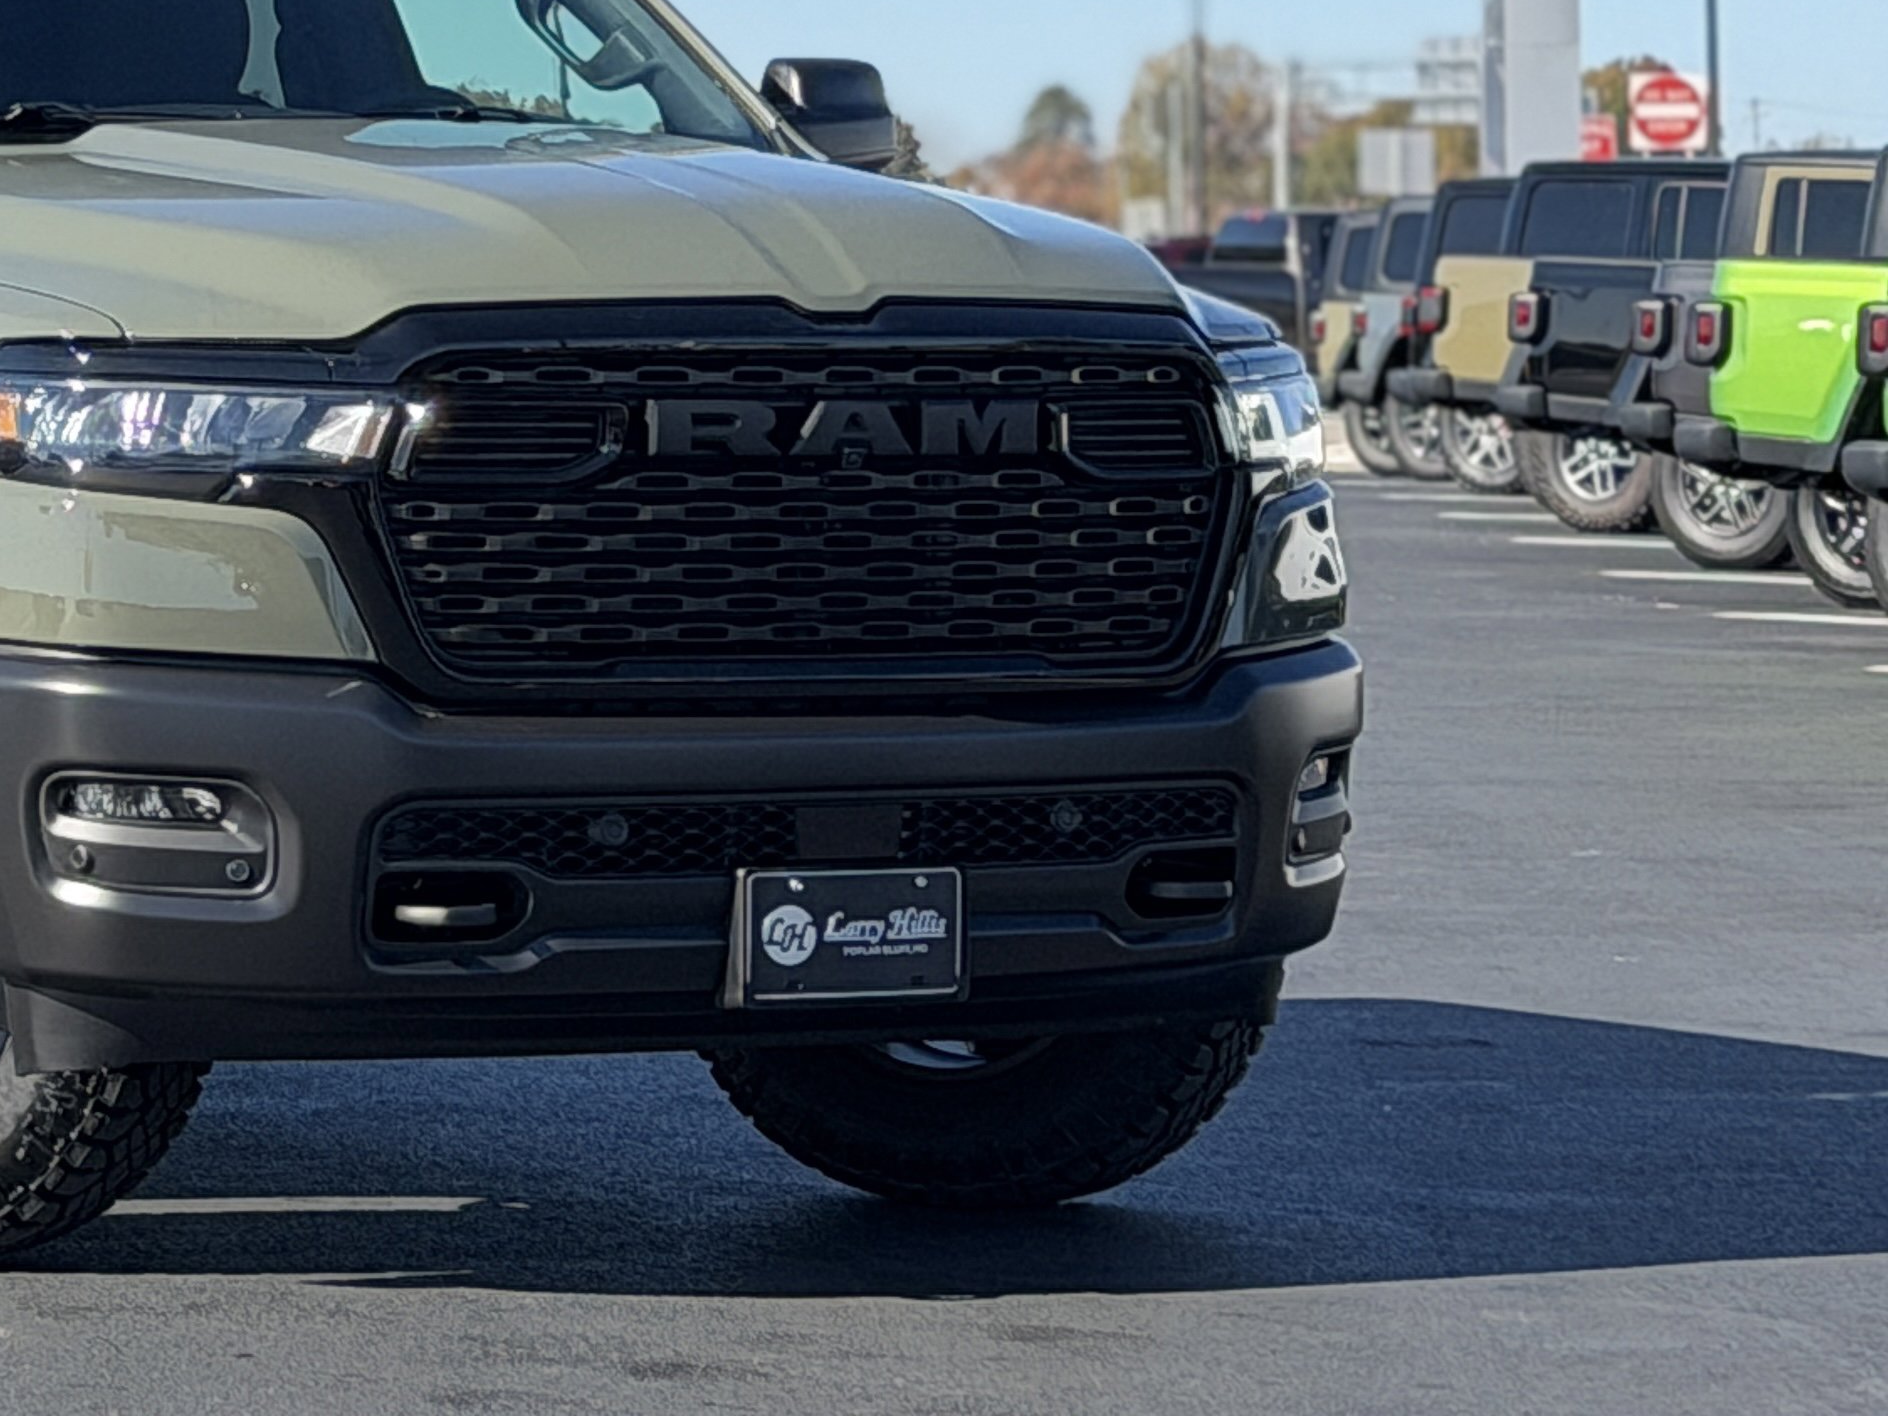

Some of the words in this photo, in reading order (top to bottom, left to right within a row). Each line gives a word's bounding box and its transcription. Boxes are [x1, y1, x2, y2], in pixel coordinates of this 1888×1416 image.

[645, 399, 1040, 456] RAM
[823, 911, 885, 944] Larry
[886, 906, 947, 940] Hillis
